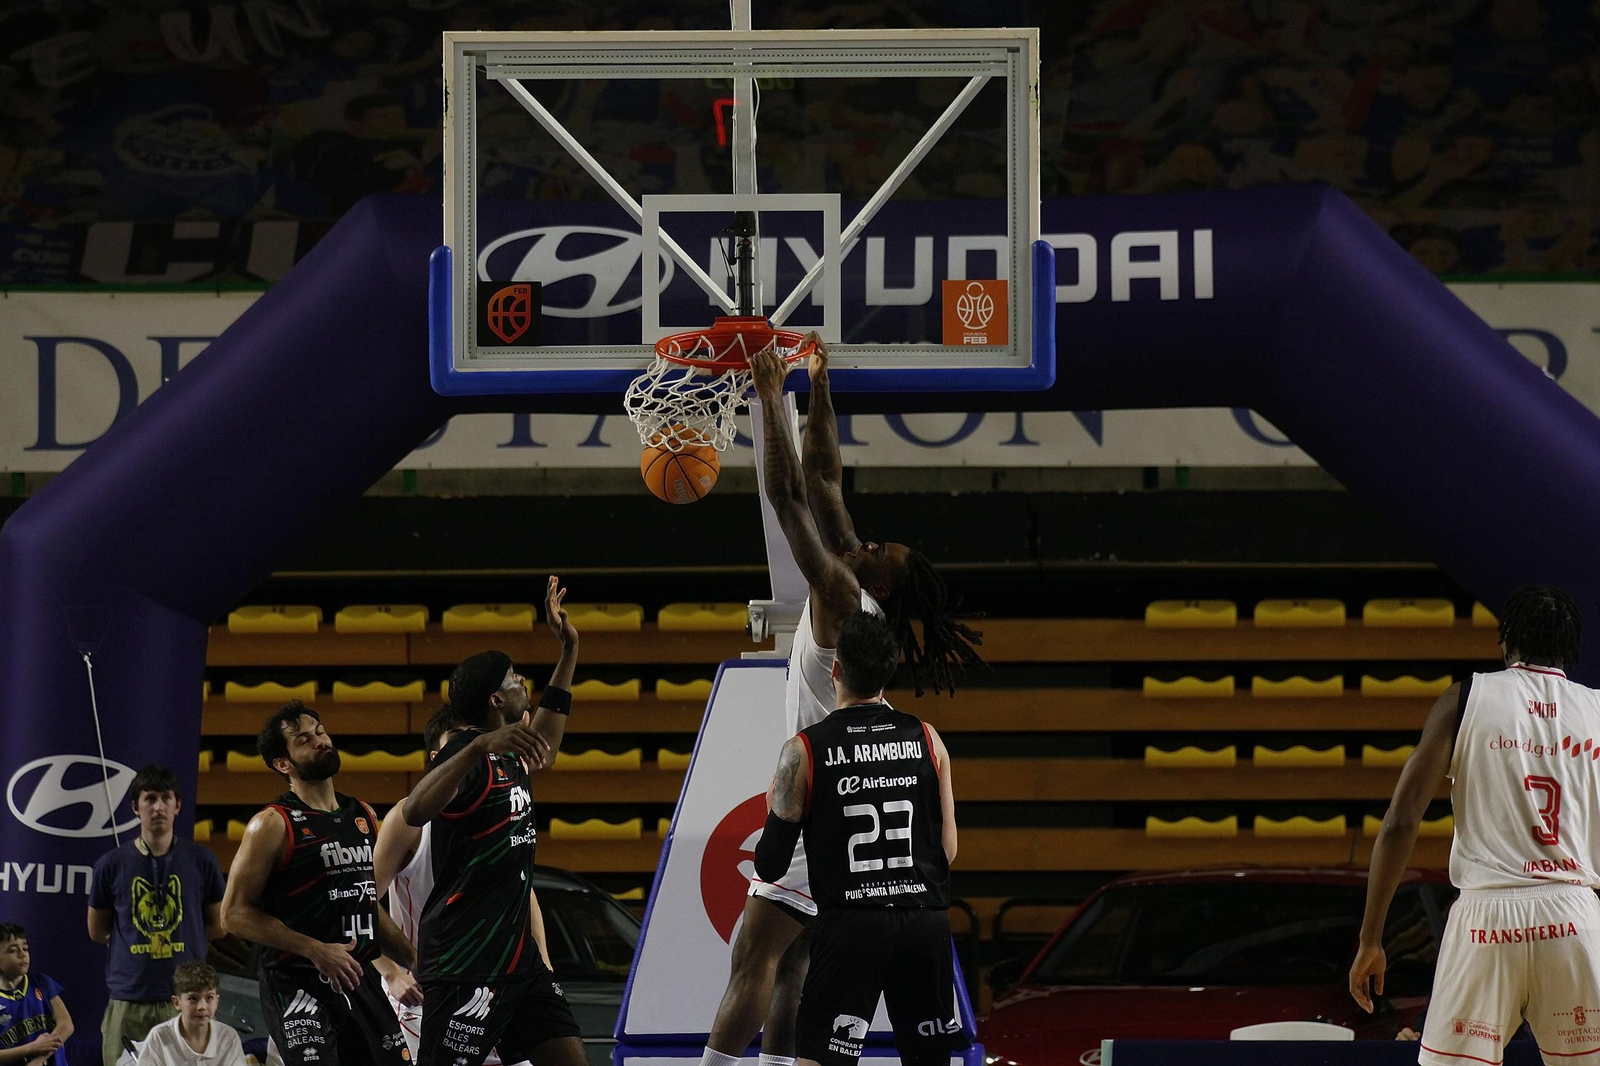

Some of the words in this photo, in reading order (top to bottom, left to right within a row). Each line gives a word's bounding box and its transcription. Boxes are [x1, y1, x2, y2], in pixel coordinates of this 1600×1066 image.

[708, 228, 1215, 308] HYUNDAI
[963, 337, 987, 345] FEB
[1528, 700, 1557, 718] SMITH
[824, 745, 851, 767] J.A.
[853, 740, 923, 763] ARAMBURU
[1489, 735, 1558, 758] cloud.gal
[862, 775, 918, 790] AirEuropa
[1524, 774, 1562, 845] 3
[843, 800, 914, 873] 23
[319, 838, 373, 868] fibwi
[341, 913, 374, 940] 44
[284, 1018, 321, 1030] ESPORTS
[285, 1027, 308, 1039] ILLES
[449, 1019, 485, 1037] ESPORTS
[287, 1036, 325, 1049] BALEARS
[445, 1029, 470, 1044] ILLES
[1469, 1028, 1502, 1042] OURENSE
[442, 1038, 481, 1057] BALEARS
